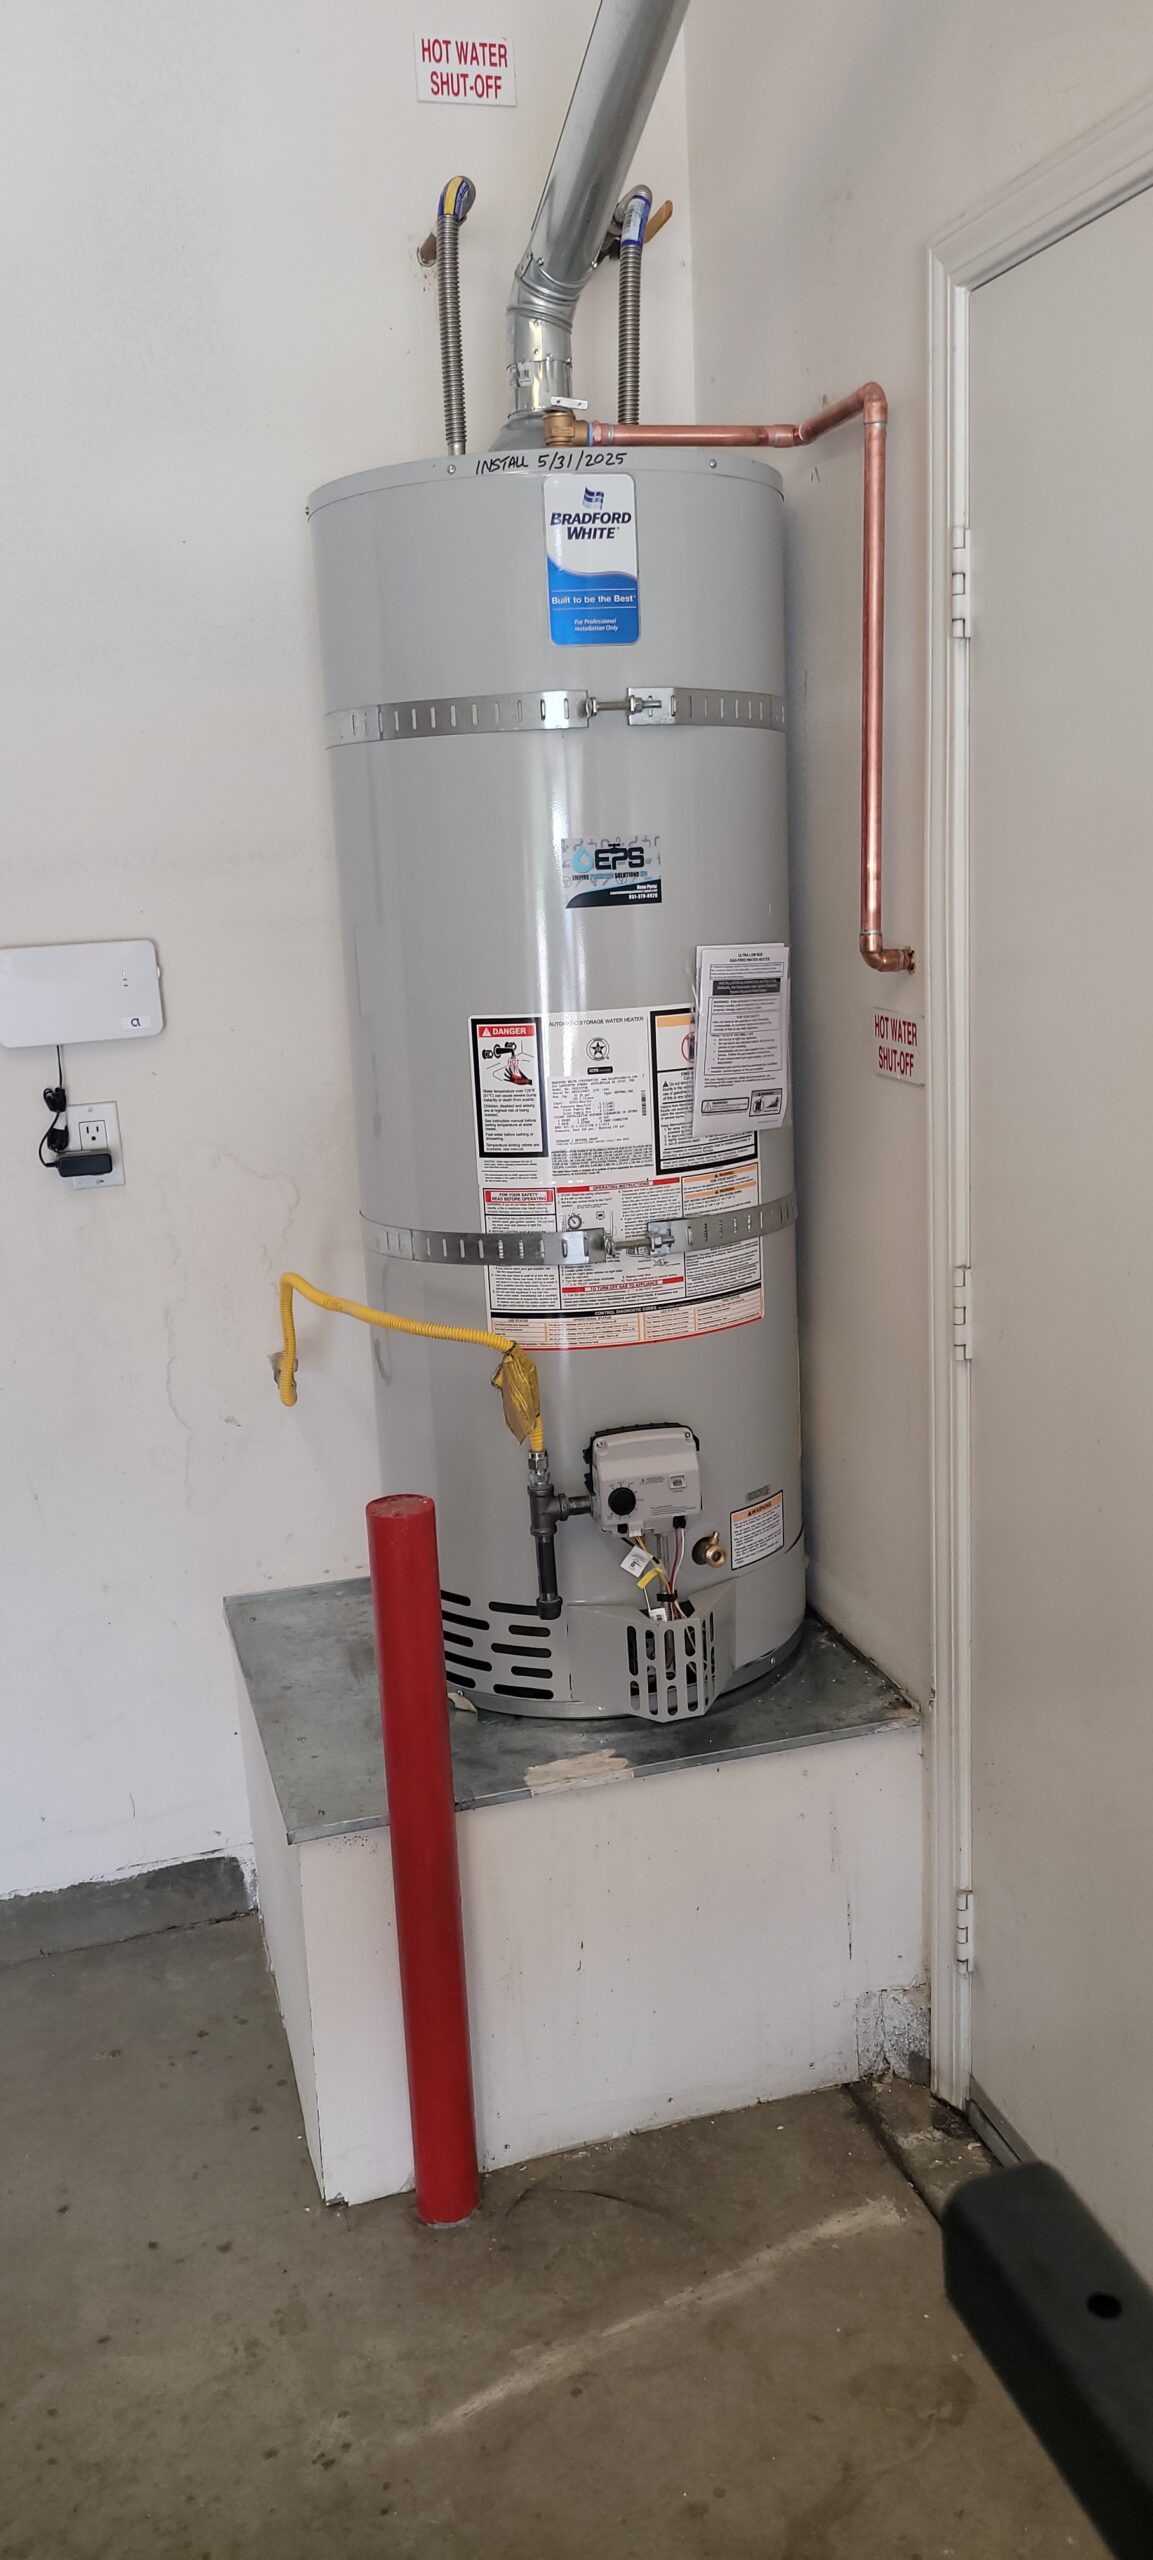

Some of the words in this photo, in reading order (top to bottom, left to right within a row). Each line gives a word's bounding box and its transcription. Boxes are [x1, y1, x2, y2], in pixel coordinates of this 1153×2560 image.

[421, 38, 451, 64] HOT
[455, 41, 508, 68] WATER
[430, 70, 502, 99] SHUT-OFF
[475, 456, 529, 475] INSTALL
[538, 450, 627, 471] 5/31/2025
[550, 512, 631, 526] BRADFORD
[567, 526, 616, 540] WHITE
[598, 595, 611, 603] the
[606, 624, 618, 632] Only
[594, 847, 644, 870] EPS
[492, 1027, 527, 1035] DANGER
[874, 1014, 889, 1040] HOT
[890, 1018, 918, 1047] WATER
[879, 1045, 914, 1078] SHUT-OFF
